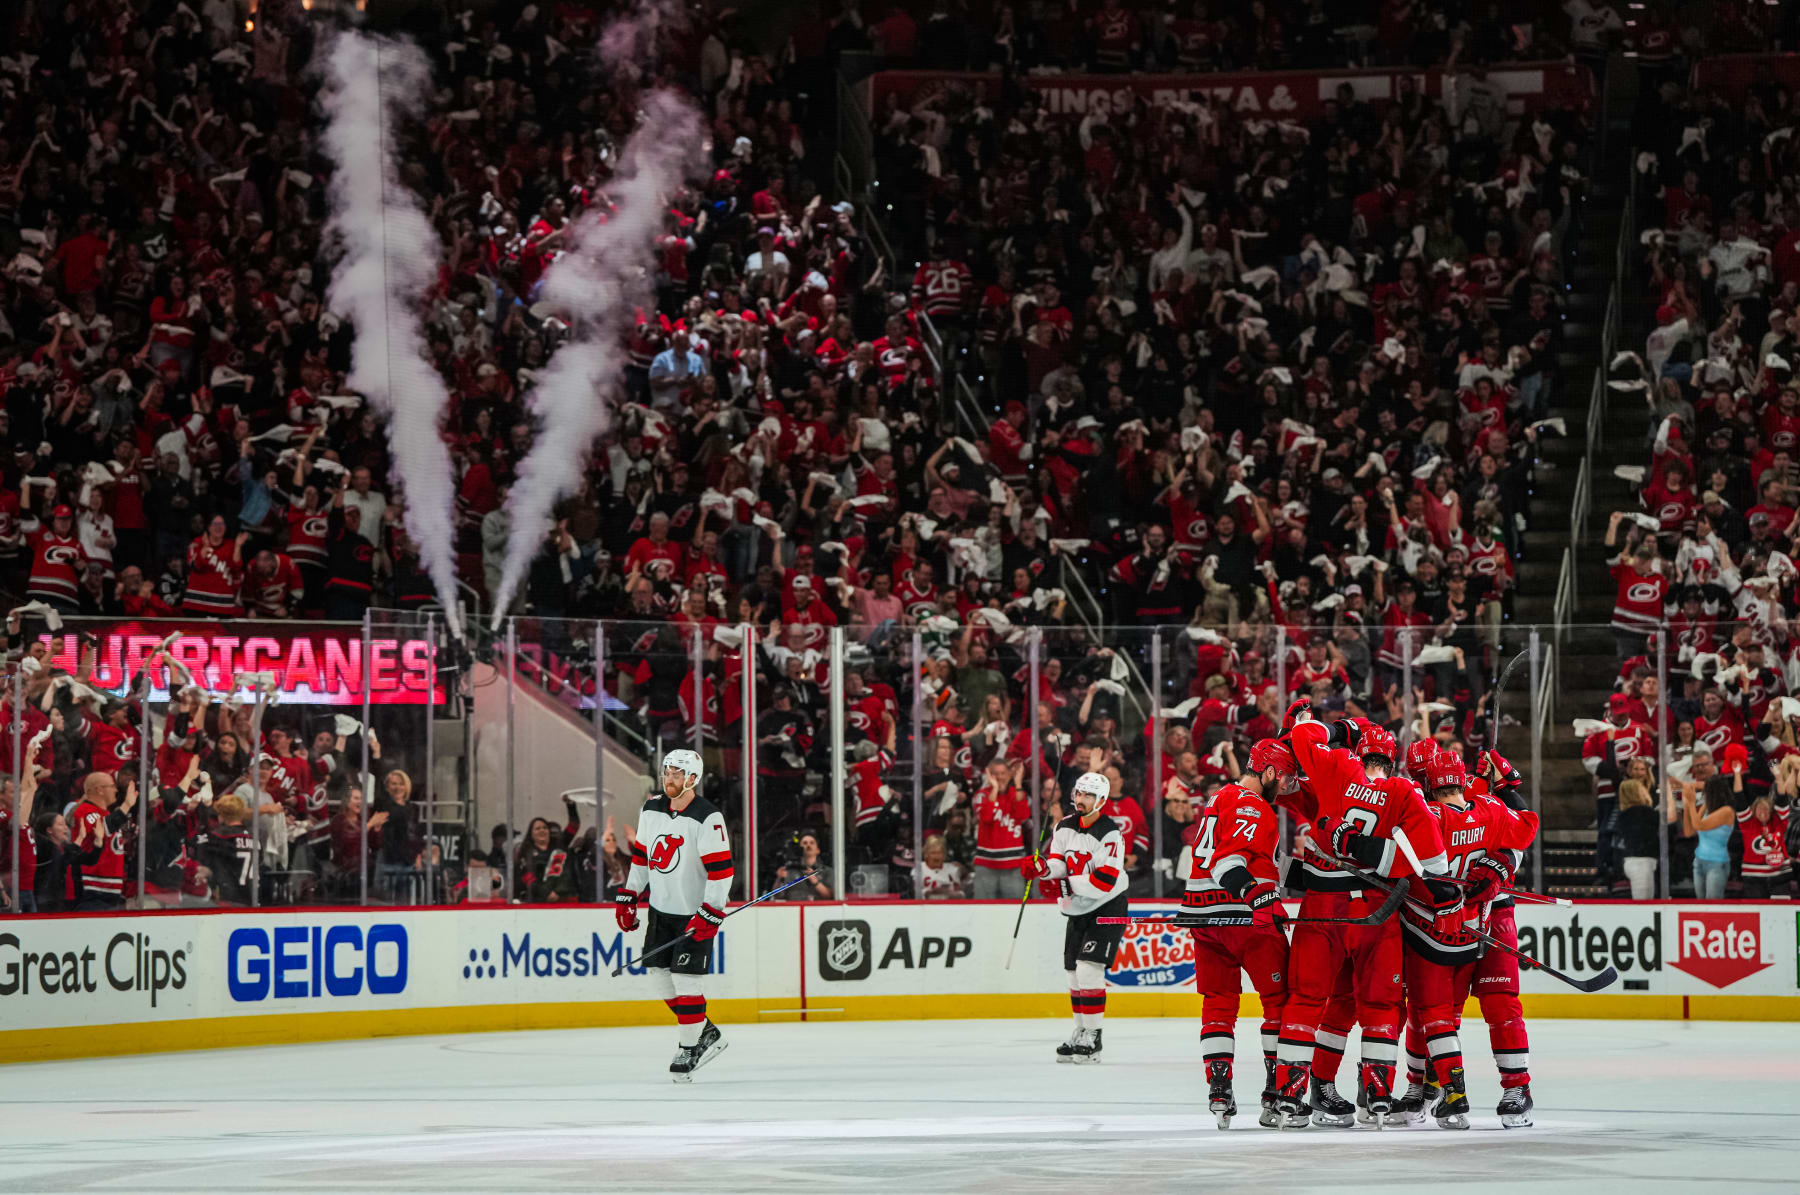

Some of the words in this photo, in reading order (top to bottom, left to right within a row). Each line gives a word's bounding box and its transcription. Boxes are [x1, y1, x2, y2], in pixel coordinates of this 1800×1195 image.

[1269, 84, 1298, 111] &
[926, 267, 961, 296] 26
[1344, 782, 1388, 807] BURNS
[713, 824, 725, 842] 7
[1232, 818, 1258, 842] 74
[1451, 825, 1486, 847] DRURY
[1478, 856, 1509, 881] BAUE
[1253, 891, 1281, 907] BAUE
[1207, 917, 1253, 927] BAUE
[1110, 935, 1196, 973] Mike's
[1517, 911, 1663, 972] anteed
[1682, 919, 1757, 960] Rate
[0, 932, 97, 996] Great
[227, 923, 409, 1003] GEICO
[502, 931, 725, 978] MassMul
[1136, 969, 1176, 986] SUBS
[1479, 975, 1512, 985] BAUER
